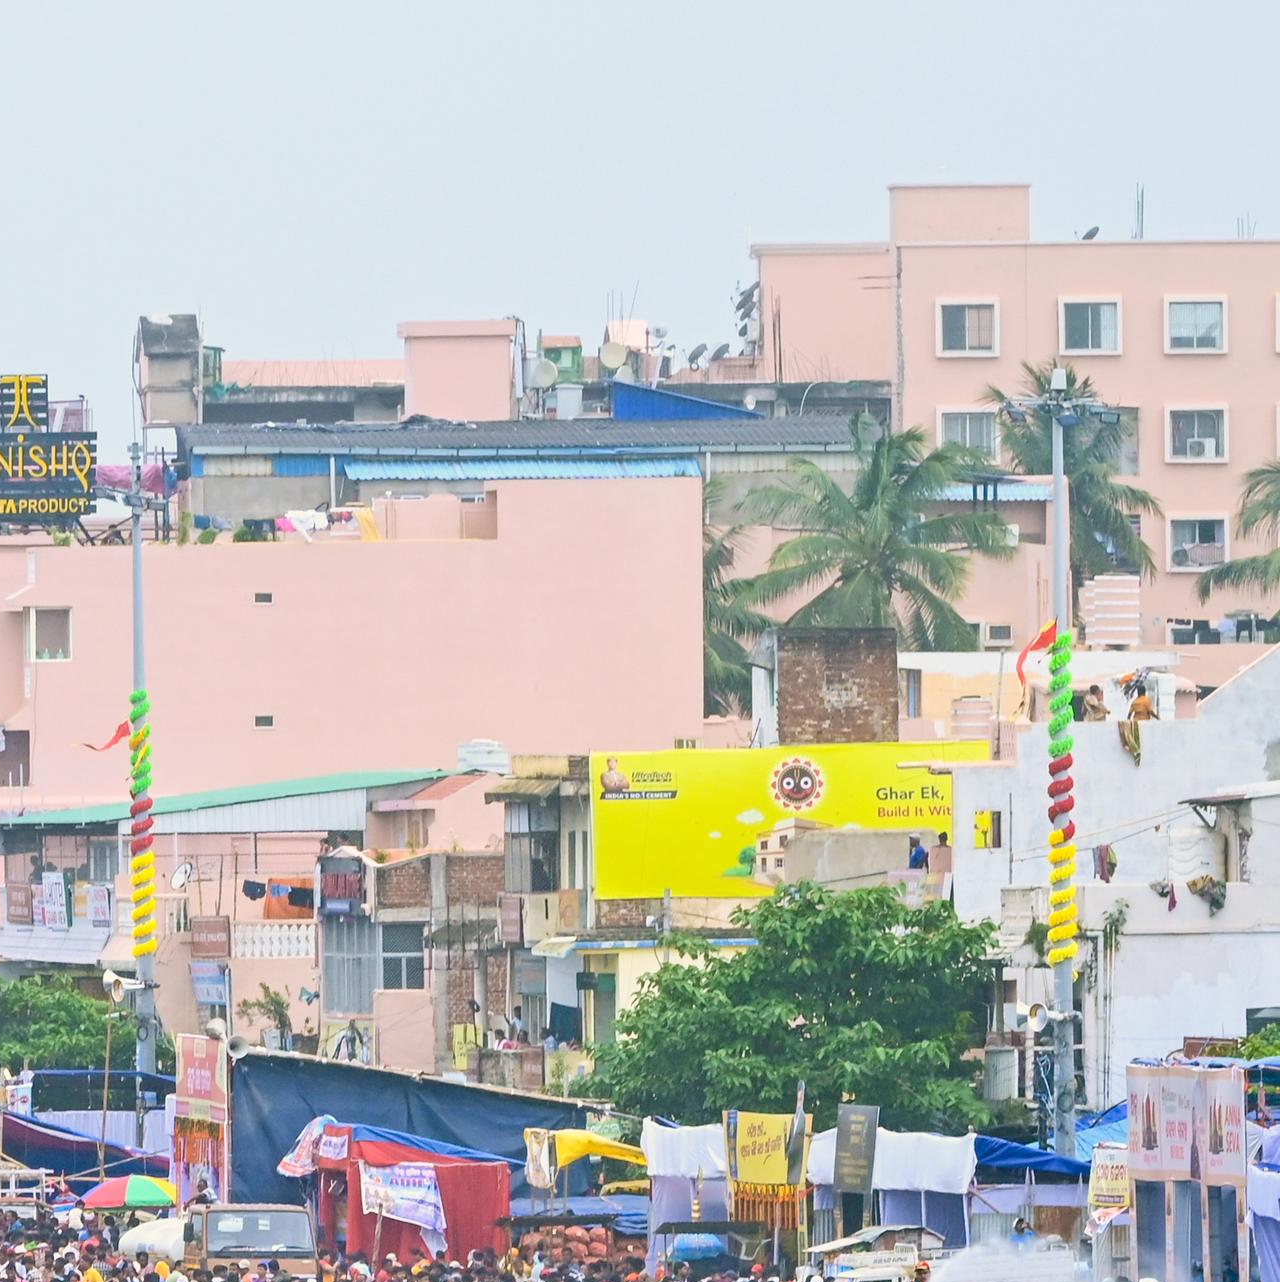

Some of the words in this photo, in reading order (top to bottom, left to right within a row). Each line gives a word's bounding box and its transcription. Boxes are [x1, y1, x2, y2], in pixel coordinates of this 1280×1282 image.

[19, 498, 88, 513] PRODUCT
[876, 787, 915, 800] Ghar
[921, 785, 944, 801] Ek,
[878, 805, 910, 818] Build
[915, 806, 925, 816] It
